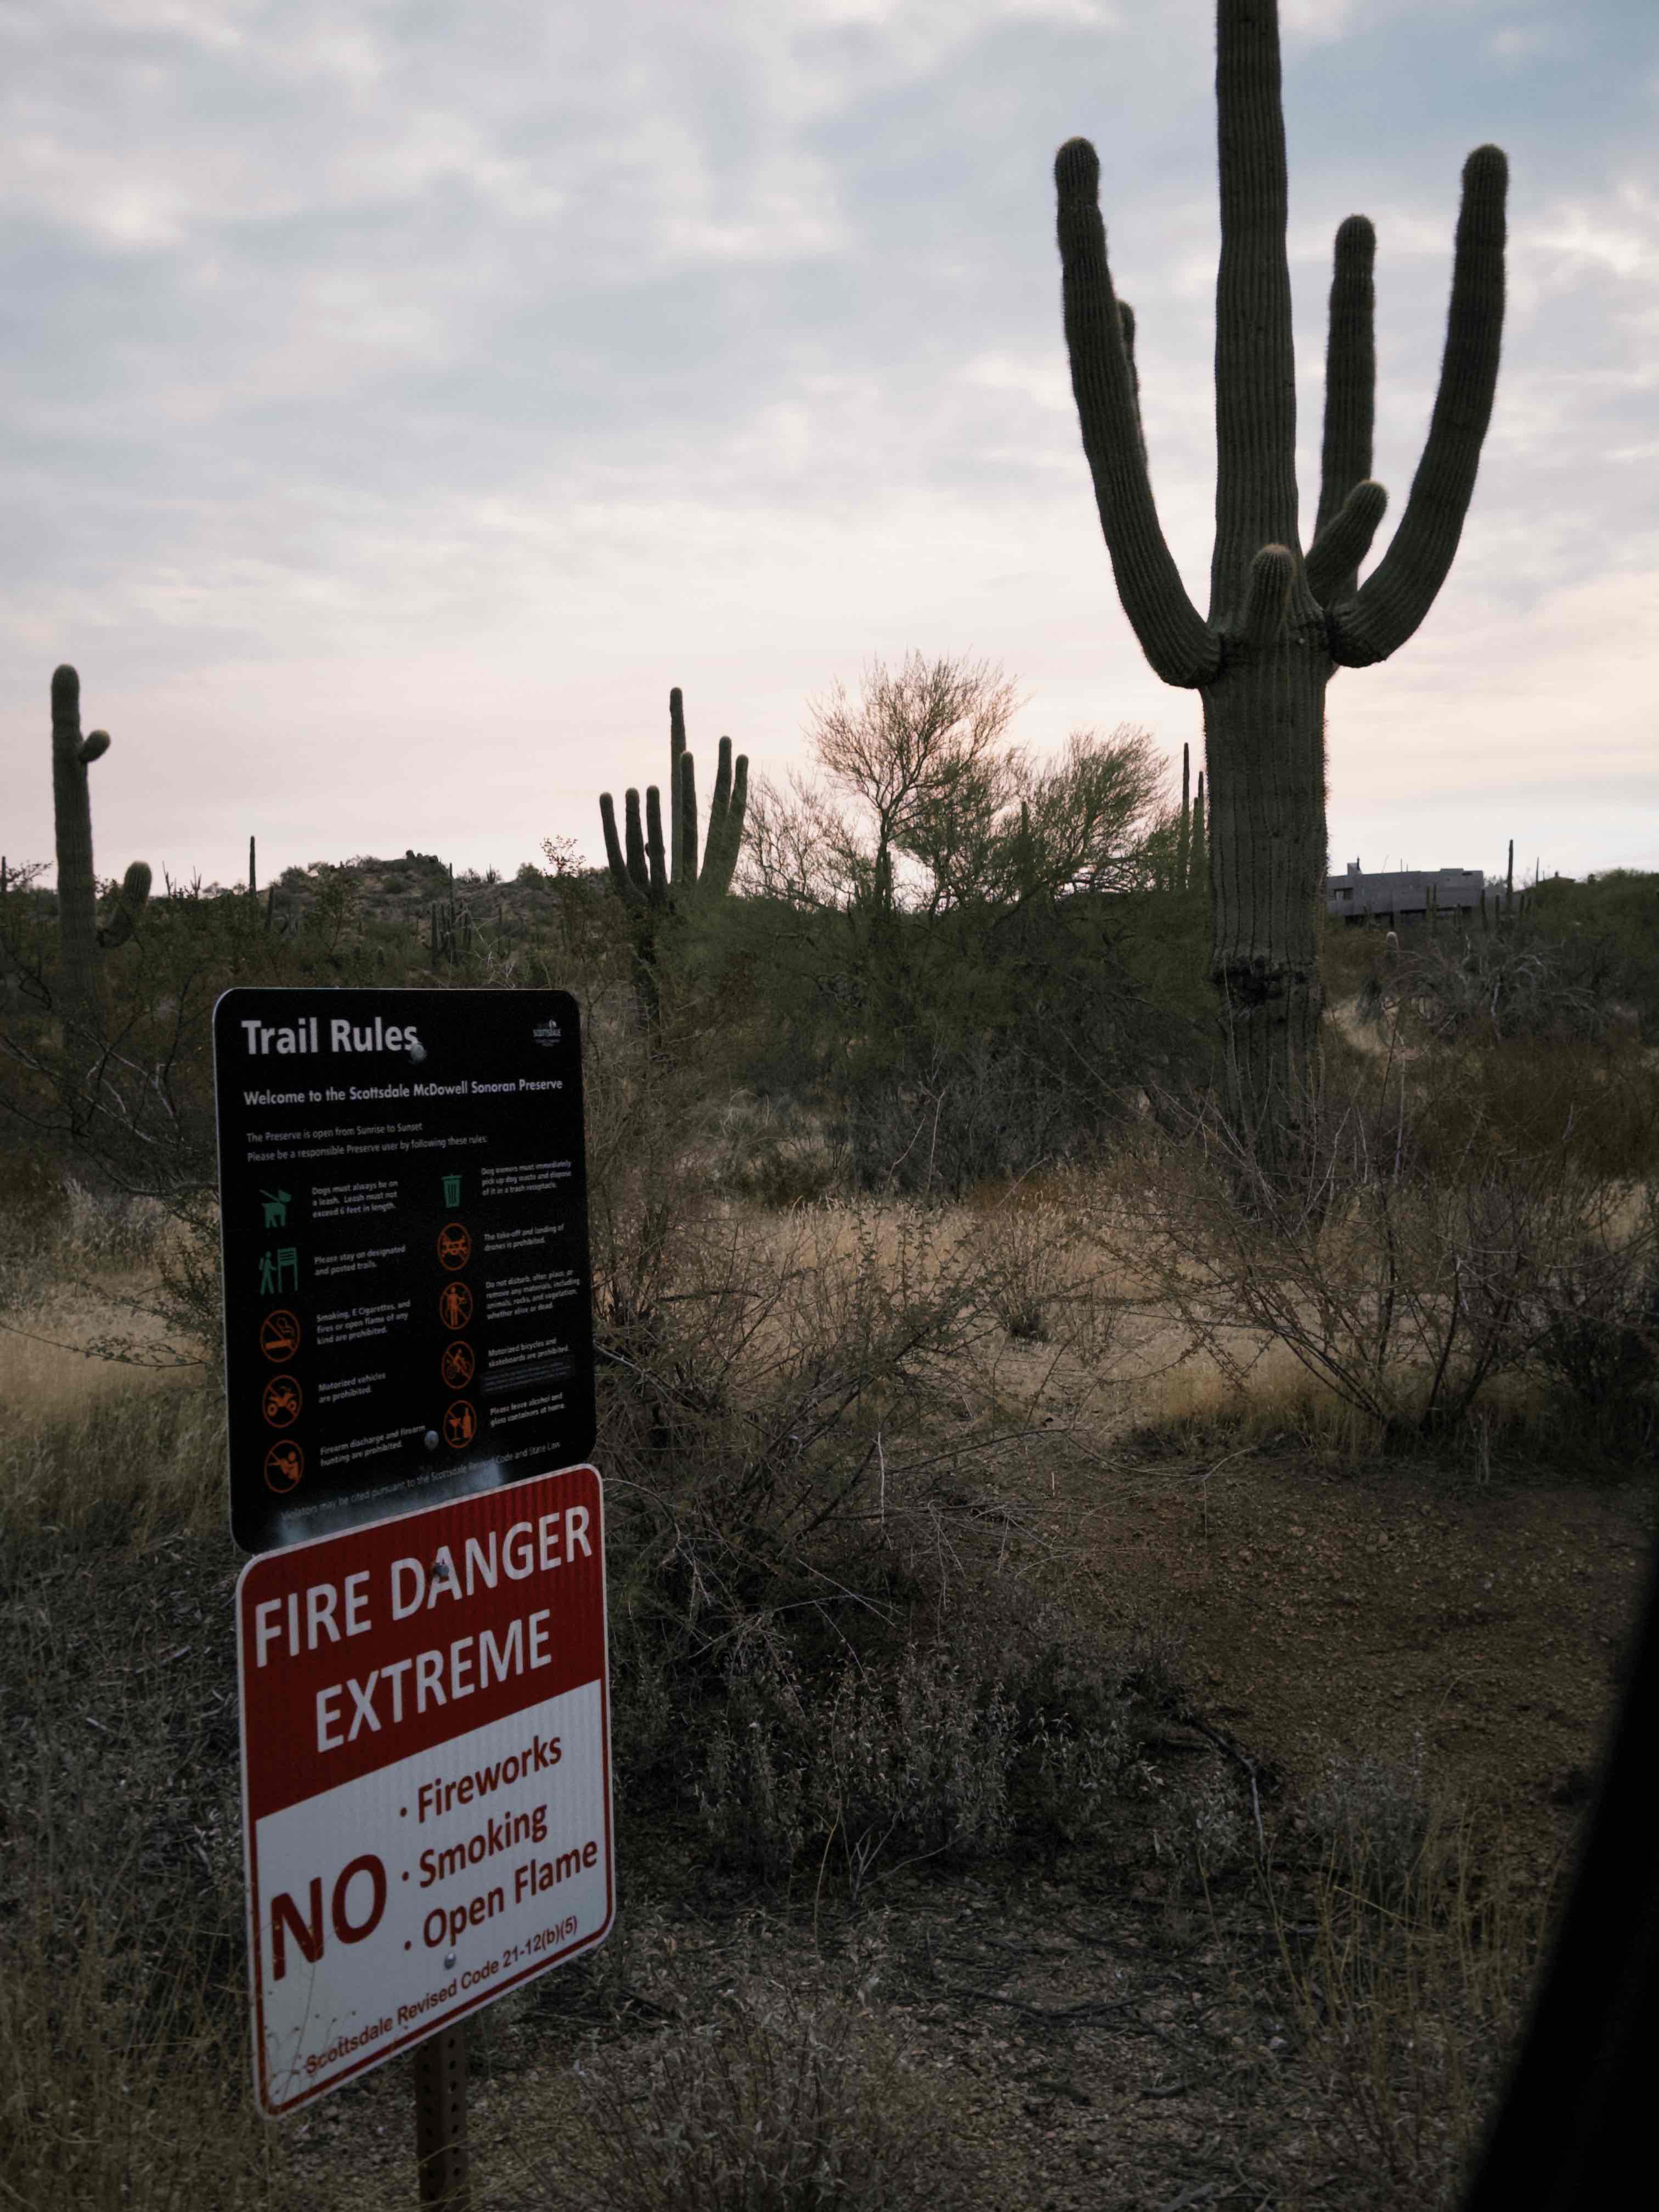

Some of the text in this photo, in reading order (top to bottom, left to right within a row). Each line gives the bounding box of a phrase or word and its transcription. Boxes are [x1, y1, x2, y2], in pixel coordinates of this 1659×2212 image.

[241, 1016, 419, 1054] Trail Rules
[244, 1078, 562, 1105] Welcome to the Scottsdale McDowell Sonoran Preserve
[246, 1132, 263, 1142] The
[265, 1132, 301, 1141] Preserve
[313, 1129, 334, 1139] open
[335, 1127, 355, 1136] from
[357, 1125, 385, 1135] Sunrise
[247, 1151, 275, 1162] Please
[277, 1149, 288, 1159] be
[298, 1145, 345, 1158] responsible
[347, 1144, 380, 1153] Preserve
[382, 1142, 398, 1151] user
[400, 1140, 410, 1151] by
[411, 1138, 446, 1148] following
[448, 1136, 467, 1145] these
[255, 1506, 592, 1667] FIRE DANGER
[316, 1609, 552, 1753] EXTREME
[417, 1735, 562, 1823] Fireworks
[419, 1804, 548, 1888] Smoking
[270, 1854, 387, 1981] NO
[423, 1841, 597, 1947] Open Flame
[305, 1915, 578, 2074] Scottsdale Revised Code 21-12(b)(5)
